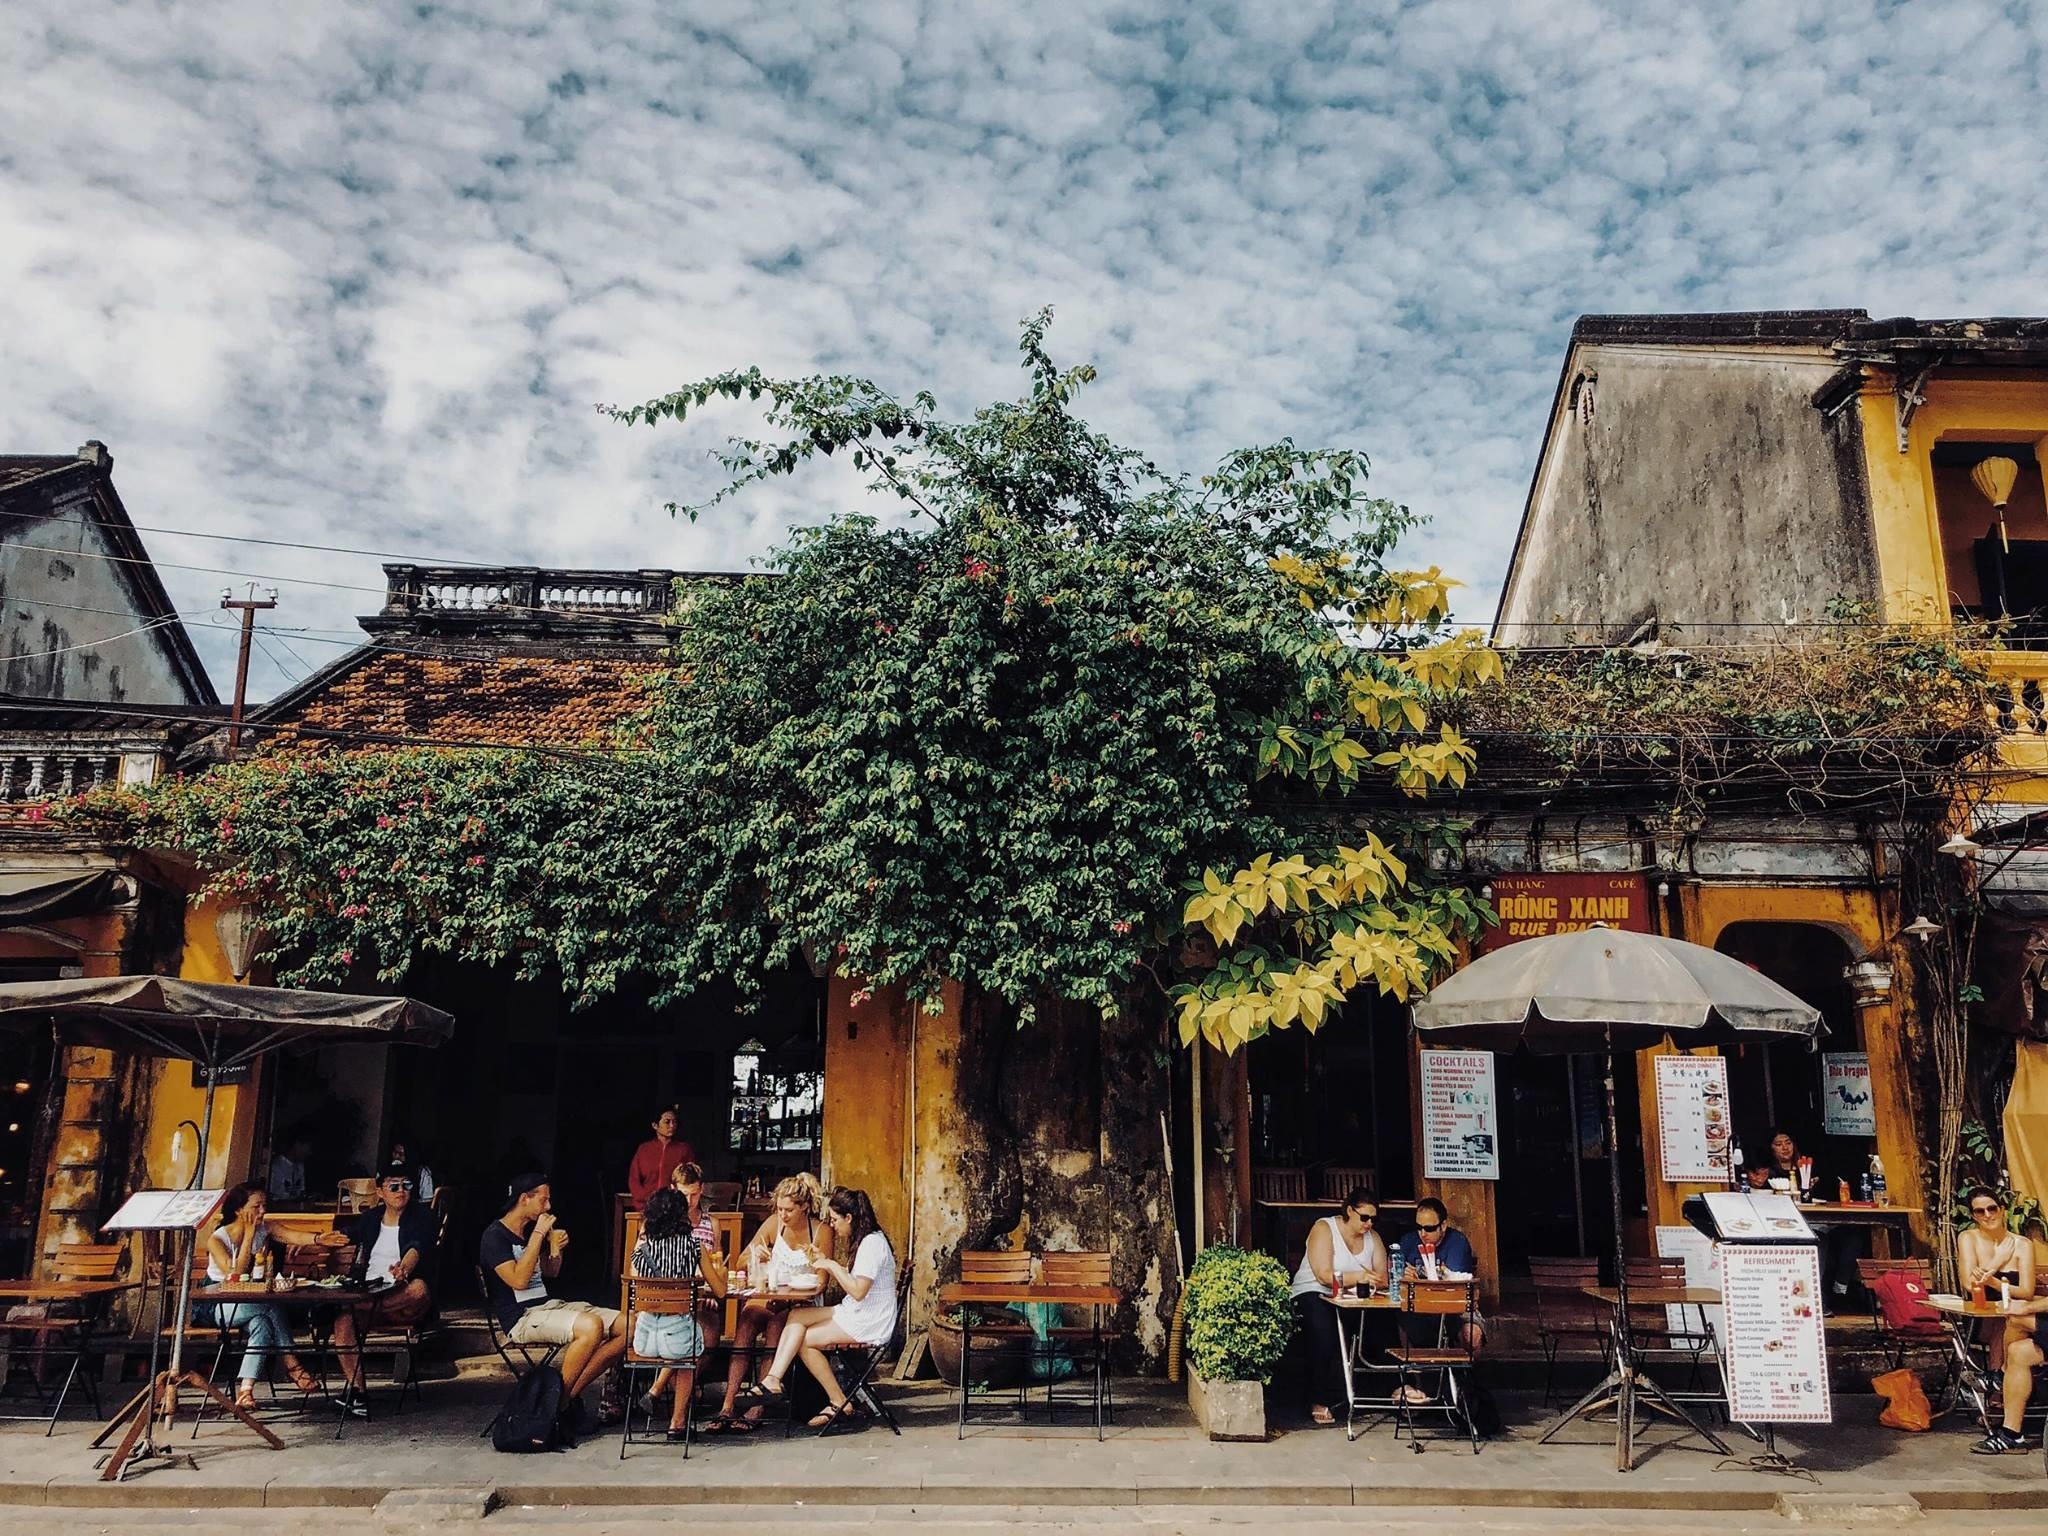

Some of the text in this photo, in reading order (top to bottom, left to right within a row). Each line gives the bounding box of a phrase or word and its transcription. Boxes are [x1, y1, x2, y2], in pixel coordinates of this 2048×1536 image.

[1609, 878, 1636, 888] CAFÉ
[1570, 897, 1629, 919] XANH
[1509, 922, 1620, 936] BLUE DRAN
[1429, 1056, 1485, 1067] COCKTAILS
[1829, 1065, 1868, 1078] Blue Dragon
